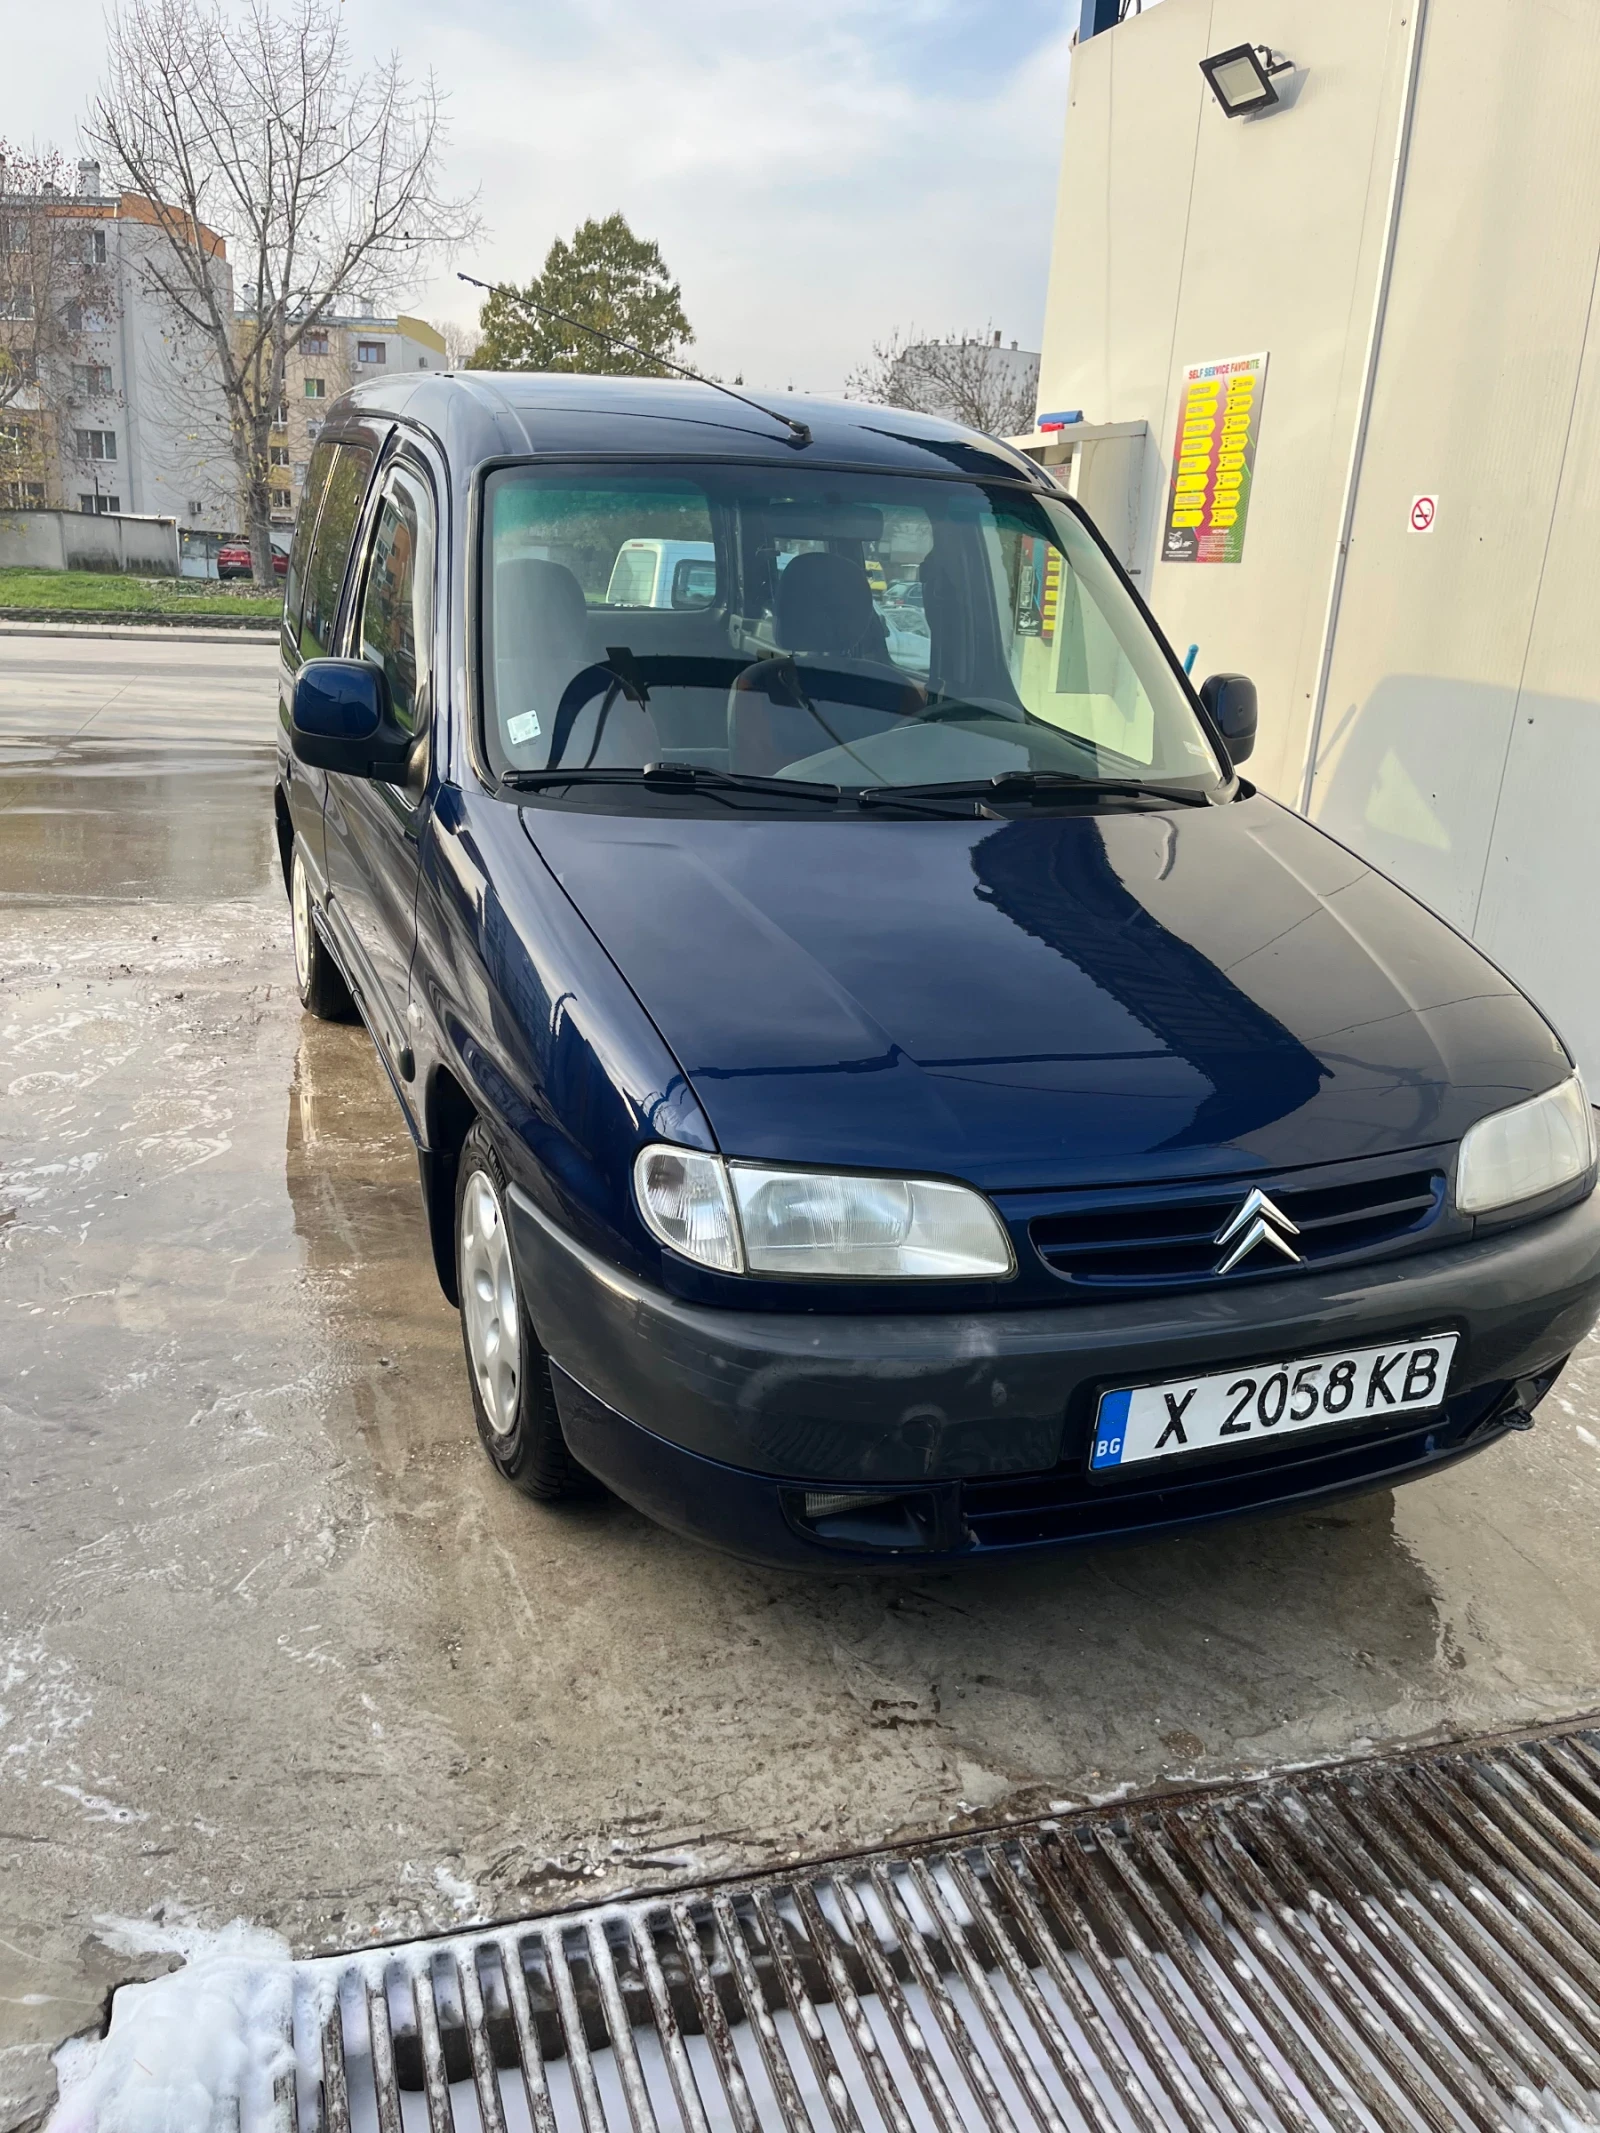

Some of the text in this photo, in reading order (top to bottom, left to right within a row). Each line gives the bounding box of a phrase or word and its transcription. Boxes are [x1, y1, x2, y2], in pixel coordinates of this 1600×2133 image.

[1189, 359, 1259, 380] SELF SERVICE FAVORITE
[1154, 1347, 1439, 1449] X 2058 KB
[1096, 1438, 1121, 1458] BG
